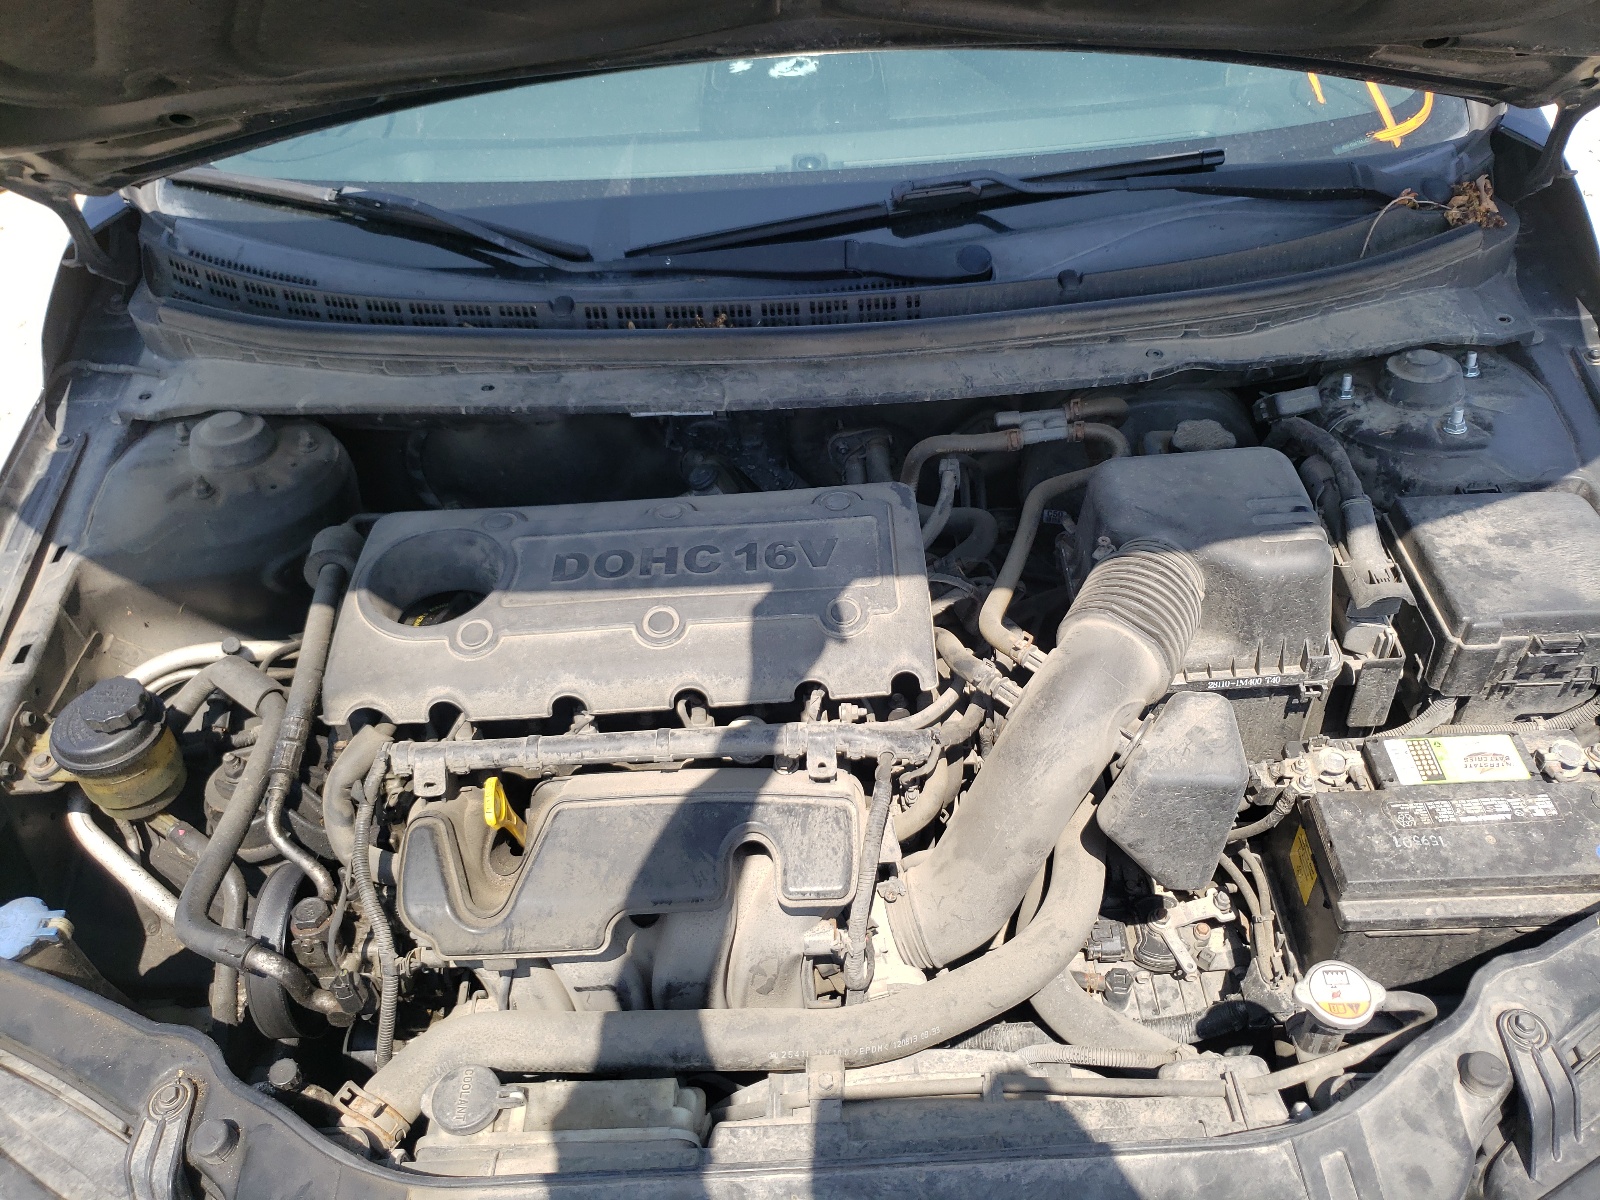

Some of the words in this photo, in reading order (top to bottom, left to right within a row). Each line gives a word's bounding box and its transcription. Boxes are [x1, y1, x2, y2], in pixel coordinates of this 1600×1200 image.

[550, 544, 721, 582] DOHC
[734, 537, 838, 571] 16V
[1207, 678, 1262, 689] 28110-1M400
[1265, 676, 1281, 684] T40
[1463, 755, 1510, 763] BATTERIES
[455, 1068, 474, 1122] COOLANT
